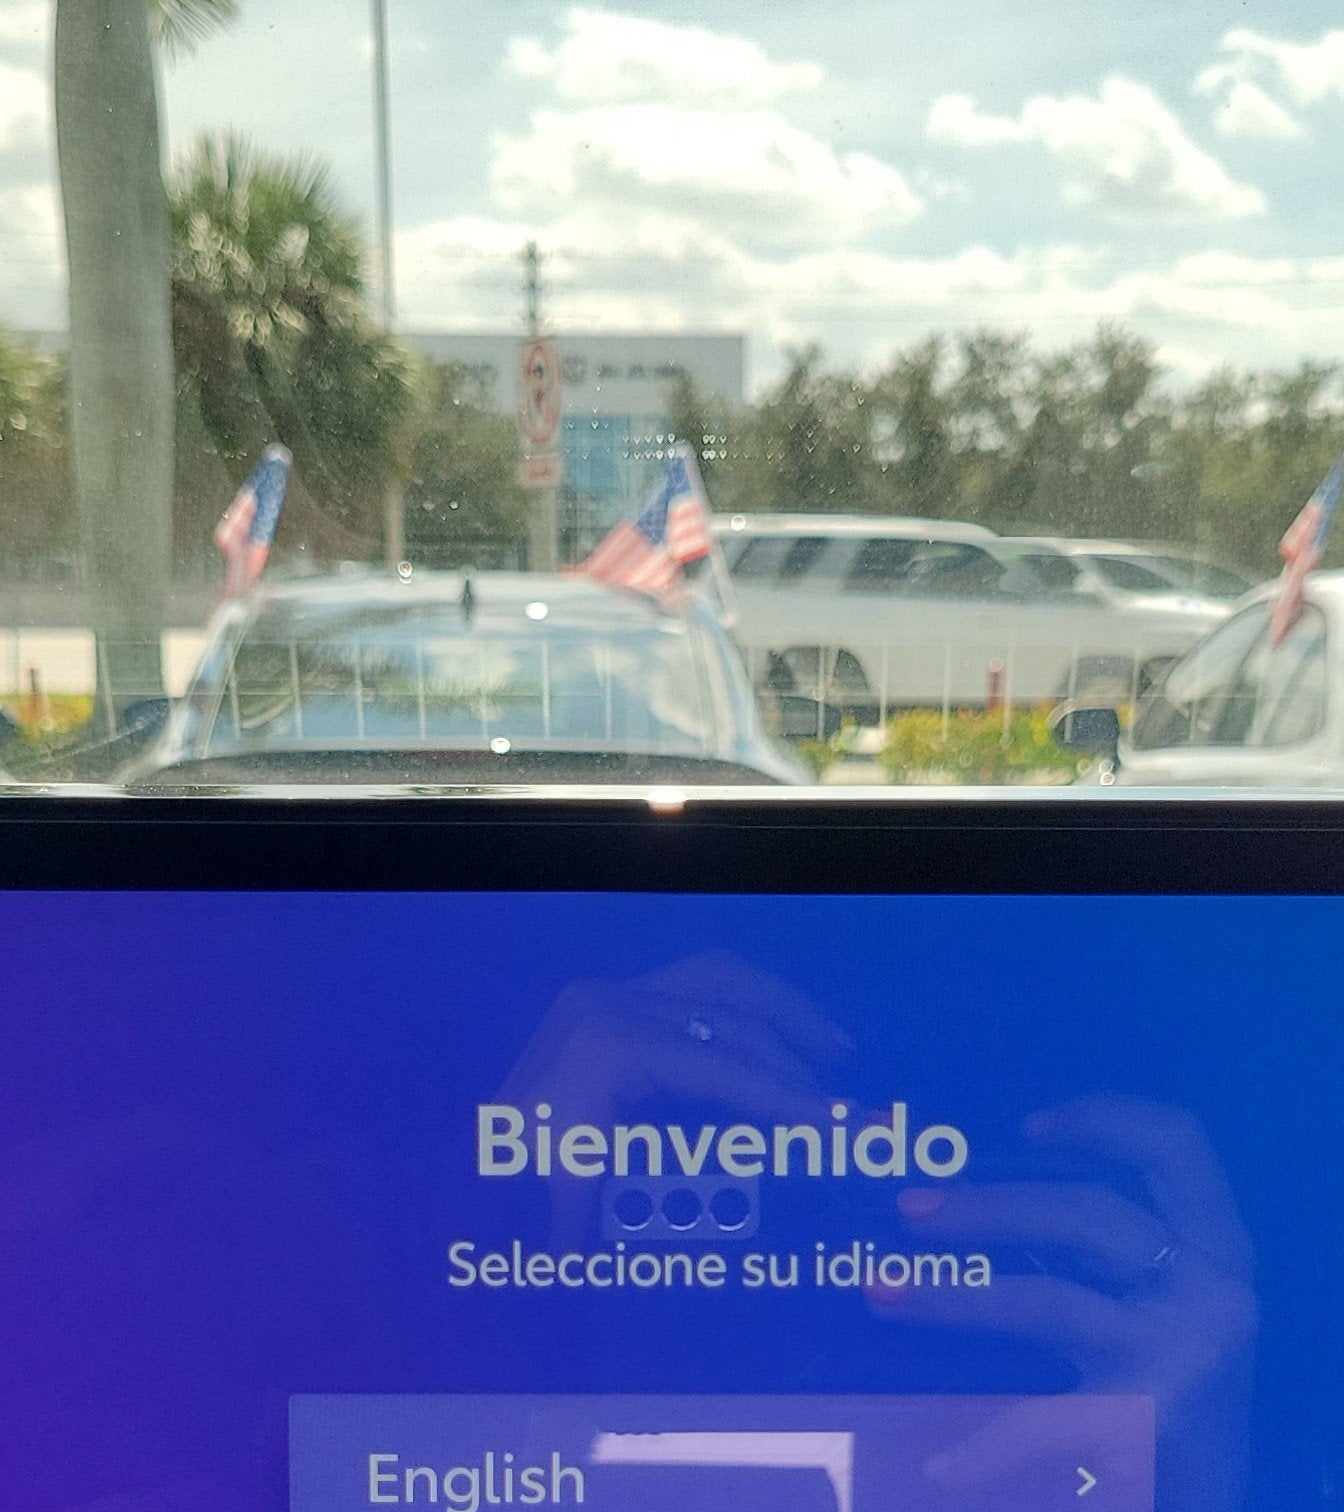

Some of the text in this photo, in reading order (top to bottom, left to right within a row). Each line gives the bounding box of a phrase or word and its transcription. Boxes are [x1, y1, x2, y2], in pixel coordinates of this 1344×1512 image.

[476, 1102, 969, 1178] Bienvenido
[447, 1241, 993, 1288] Seleccione su idioma
